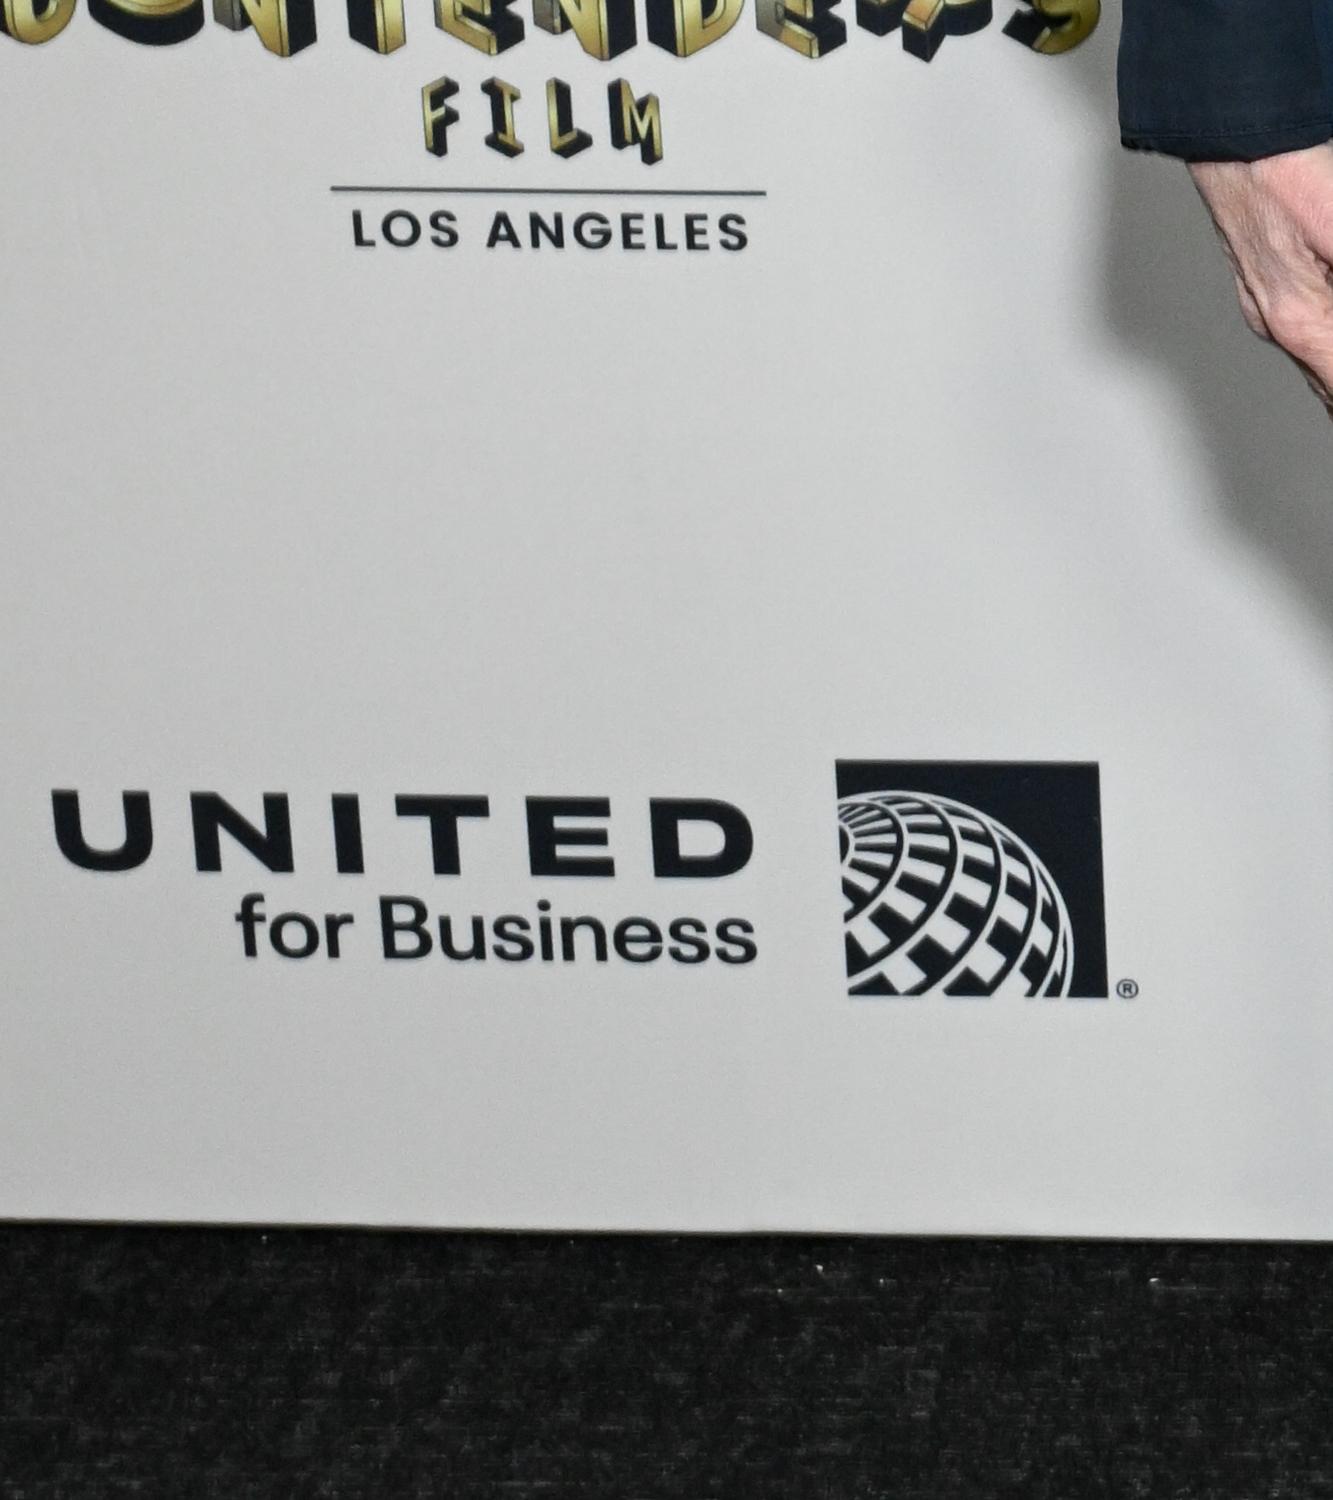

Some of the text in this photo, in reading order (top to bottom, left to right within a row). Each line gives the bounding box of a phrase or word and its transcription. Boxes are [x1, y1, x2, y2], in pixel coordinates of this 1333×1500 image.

[421, 75, 664, 167] FILM
[352, 209, 749, 253] LOS ANGELES
[49, 789, 755, 880] UNITED
[234, 892, 759, 966] for Business
